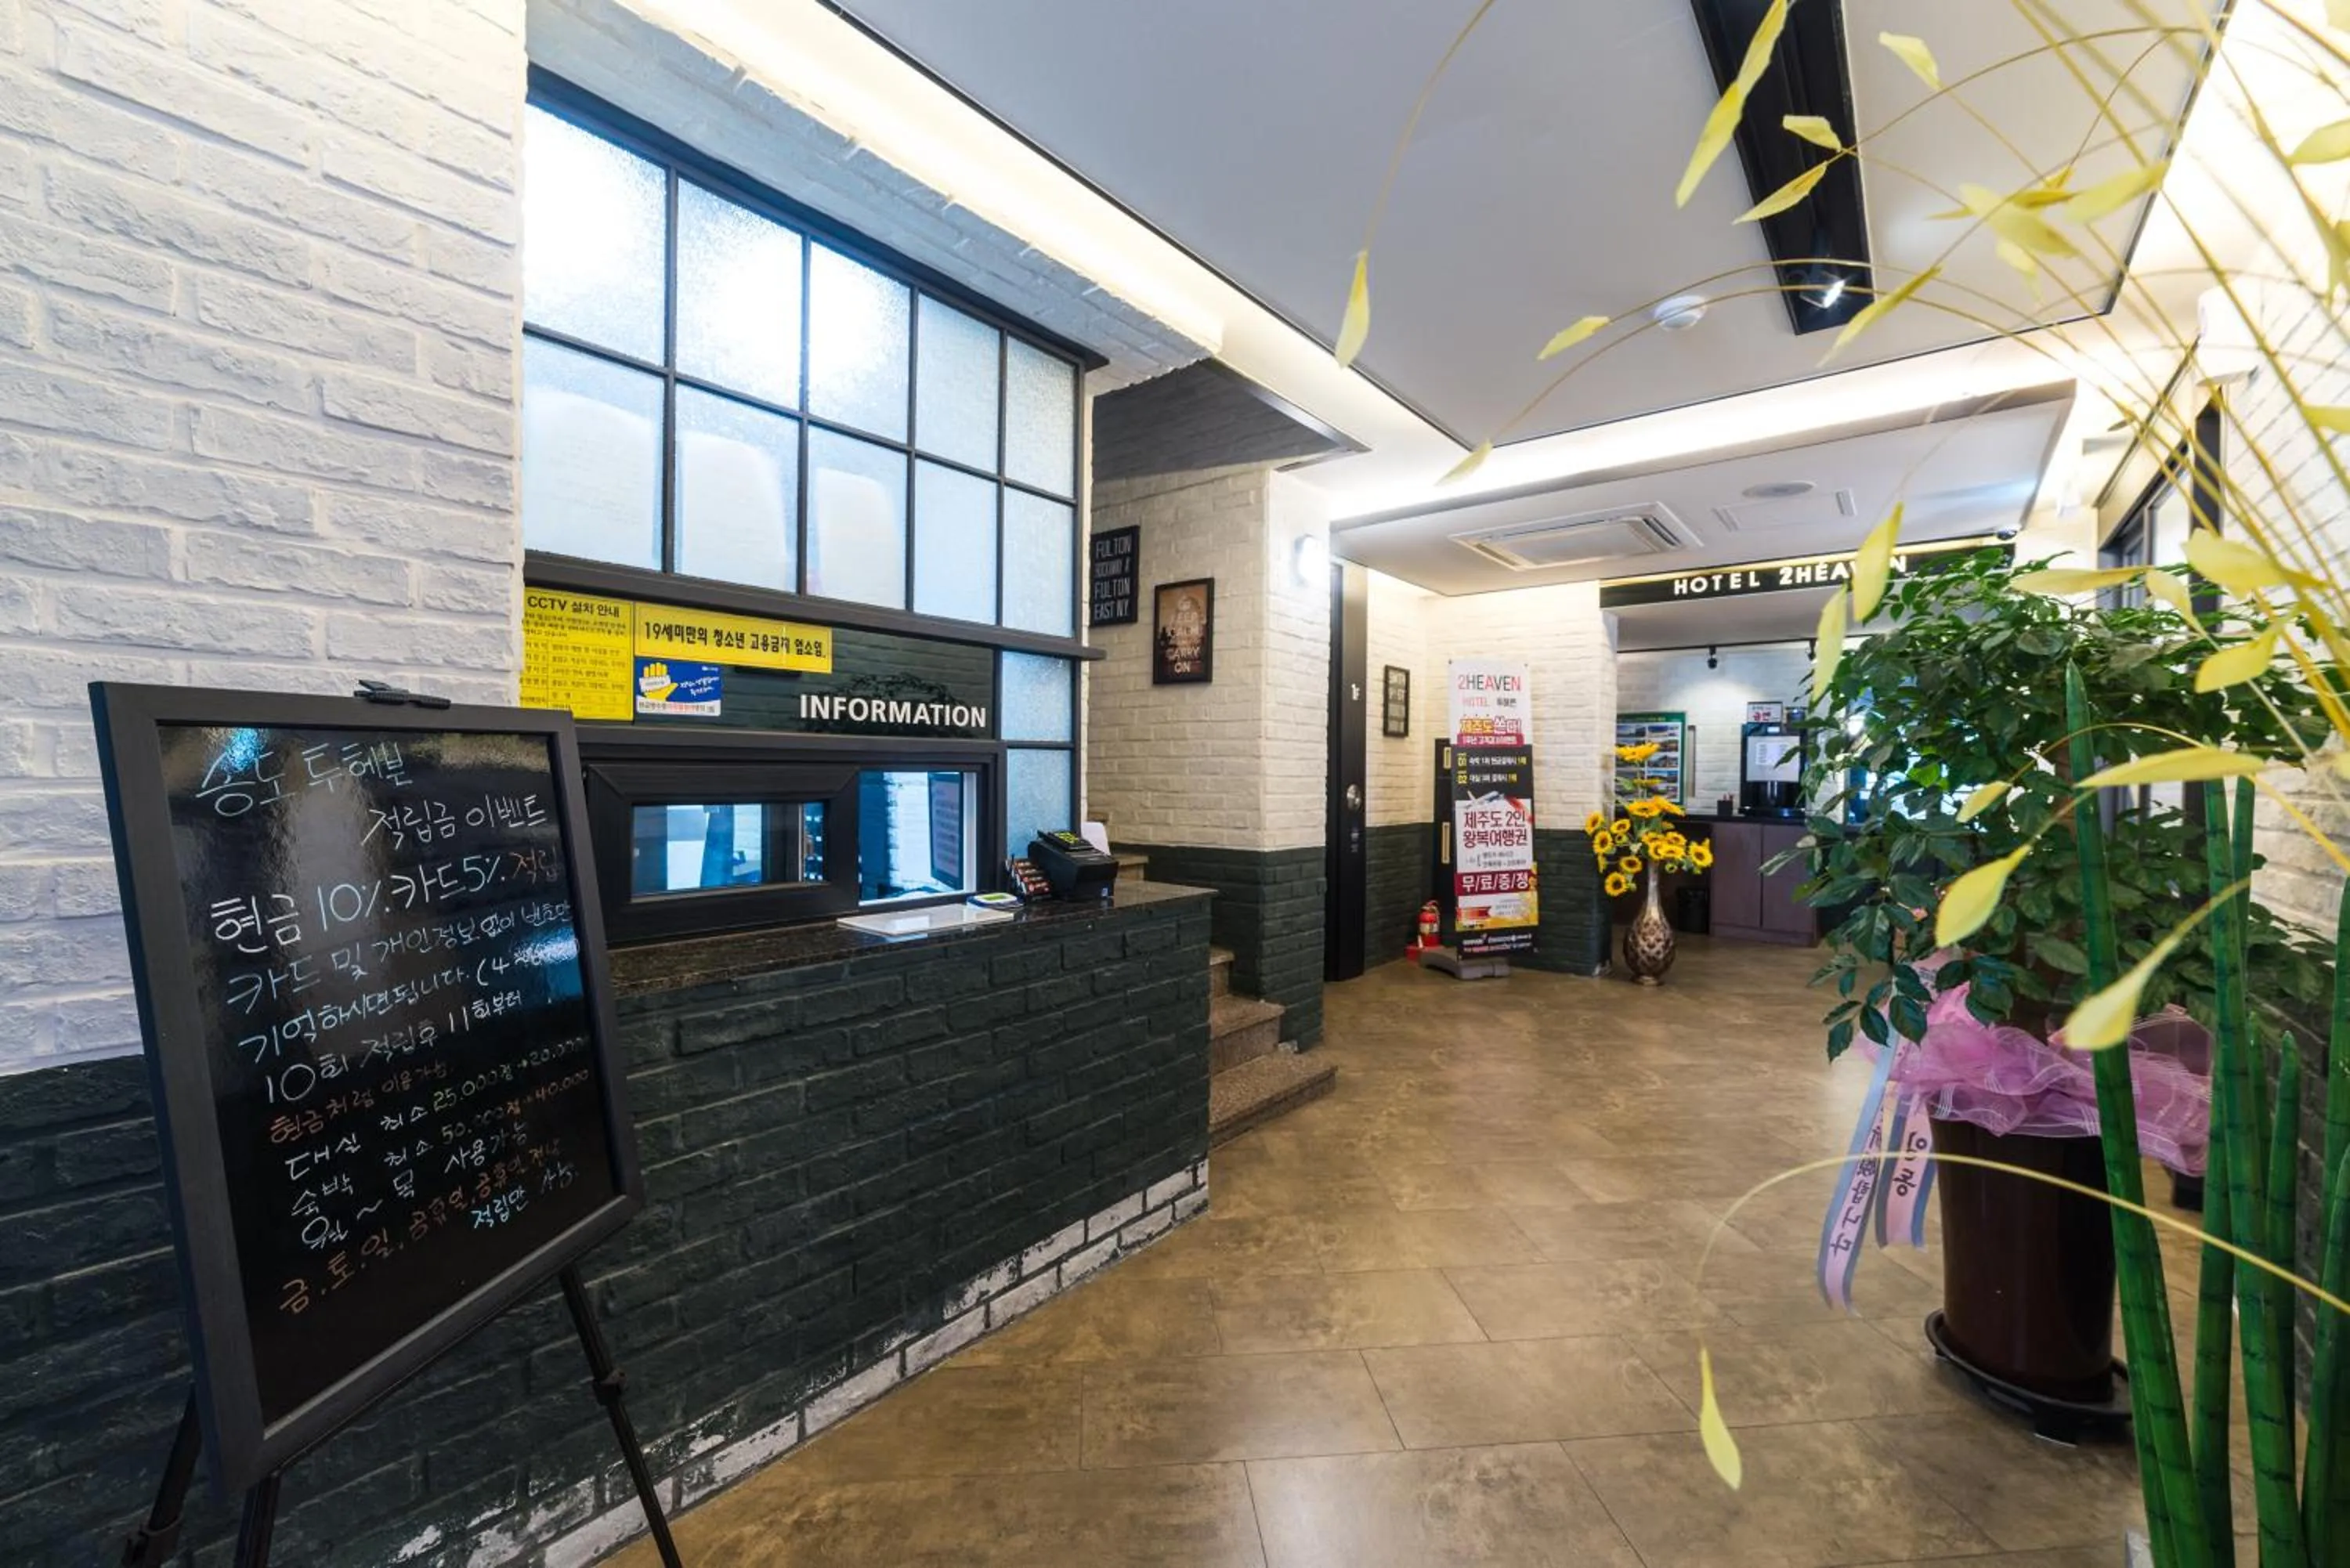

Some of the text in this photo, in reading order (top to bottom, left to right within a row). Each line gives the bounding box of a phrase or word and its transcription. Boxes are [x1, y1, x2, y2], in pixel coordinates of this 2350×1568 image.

[1096, 536, 1132, 558] FULTON
[1095, 577, 1130, 600] FULTON
[1674, 555, 1907, 594] HOTEL 2HEAN
[527, 596, 567, 612] CCTV
[598, 604, 620, 618] 안내
[714, 629, 745, 649] 청소년
[1175, 661, 1191, 674] ON
[1458, 674, 1521, 692] 2HEAVEN
[799, 693, 987, 728] INFORMATION
[360, 793, 548, 850] 적립금 이벤트
[1463, 810, 1526, 829] 제주도 2인
[1462, 827, 1528, 849] 왕복여행권
[211, 893, 301, 953] 현금
[227, 954, 322, 1015] 카드
[331, 942, 368, 981] 및
[264, 1053, 350, 1104] 10회
[284, 1133, 362, 1181] 대실
[379, 1101, 428, 1131] 최소
[291, 1172, 355, 1217] 숙박
[383, 1137, 435, 1168] 최소
